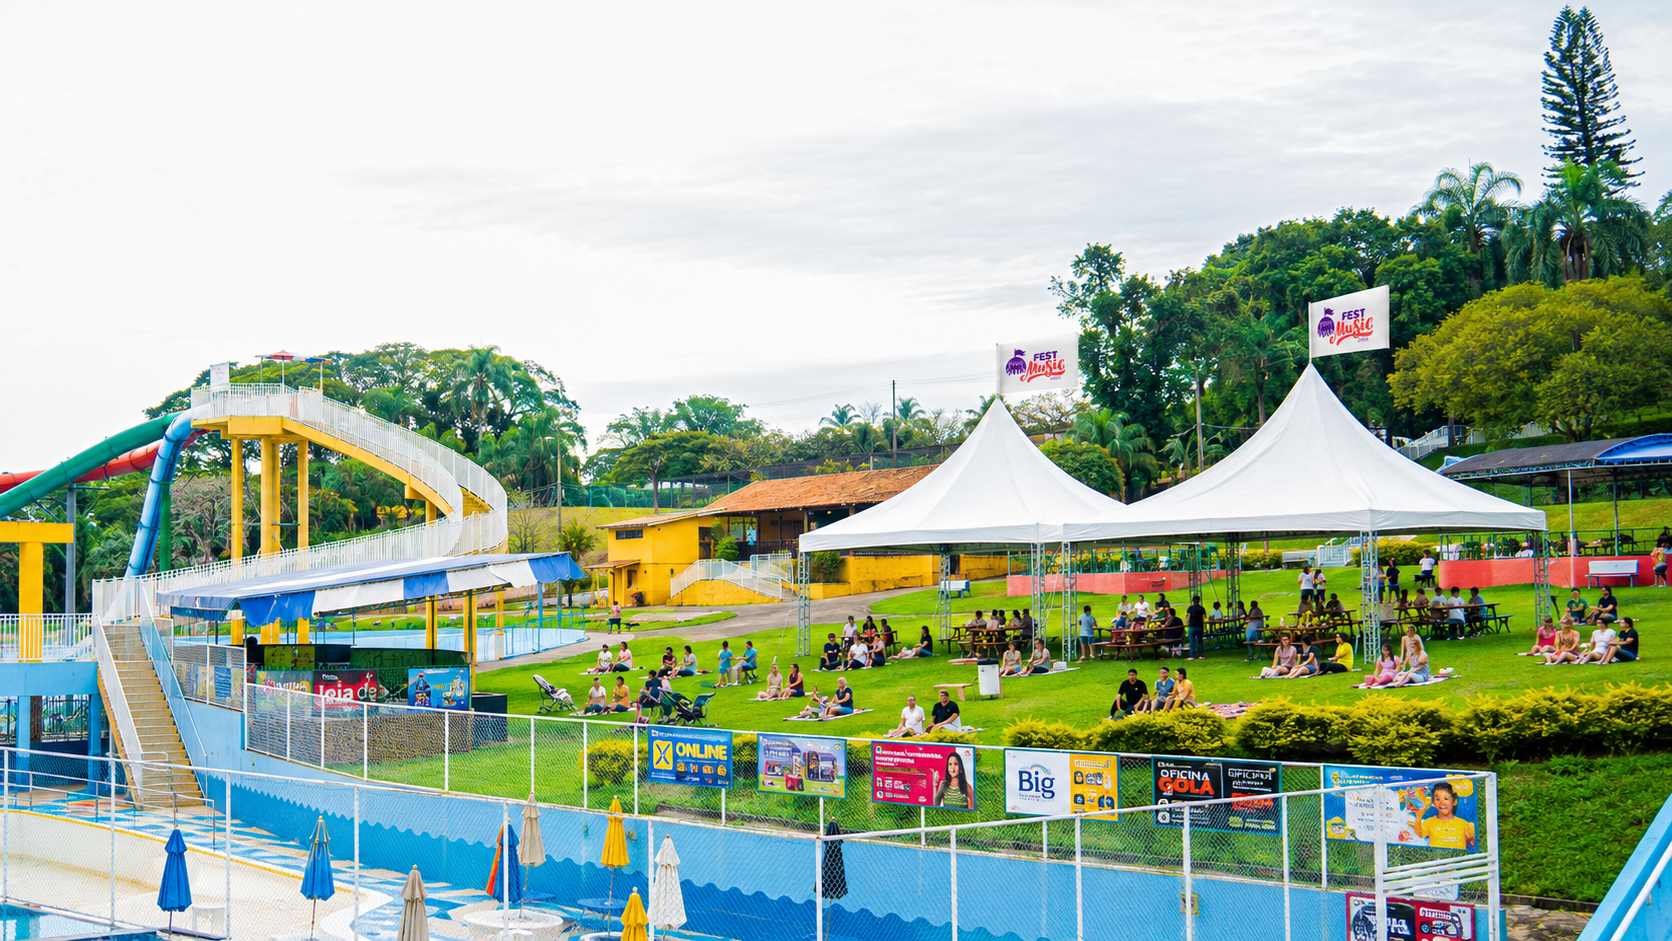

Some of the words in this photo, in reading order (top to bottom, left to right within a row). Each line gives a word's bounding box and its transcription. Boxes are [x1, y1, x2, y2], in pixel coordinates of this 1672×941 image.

[1342, 308, 1365, 321] FEST
[1033, 350, 1058, 361] FEST
[676, 742, 728, 760] ONLINE
[1160, 769, 1211, 781] OFICINA
[1018, 770, 1056, 799] Big
